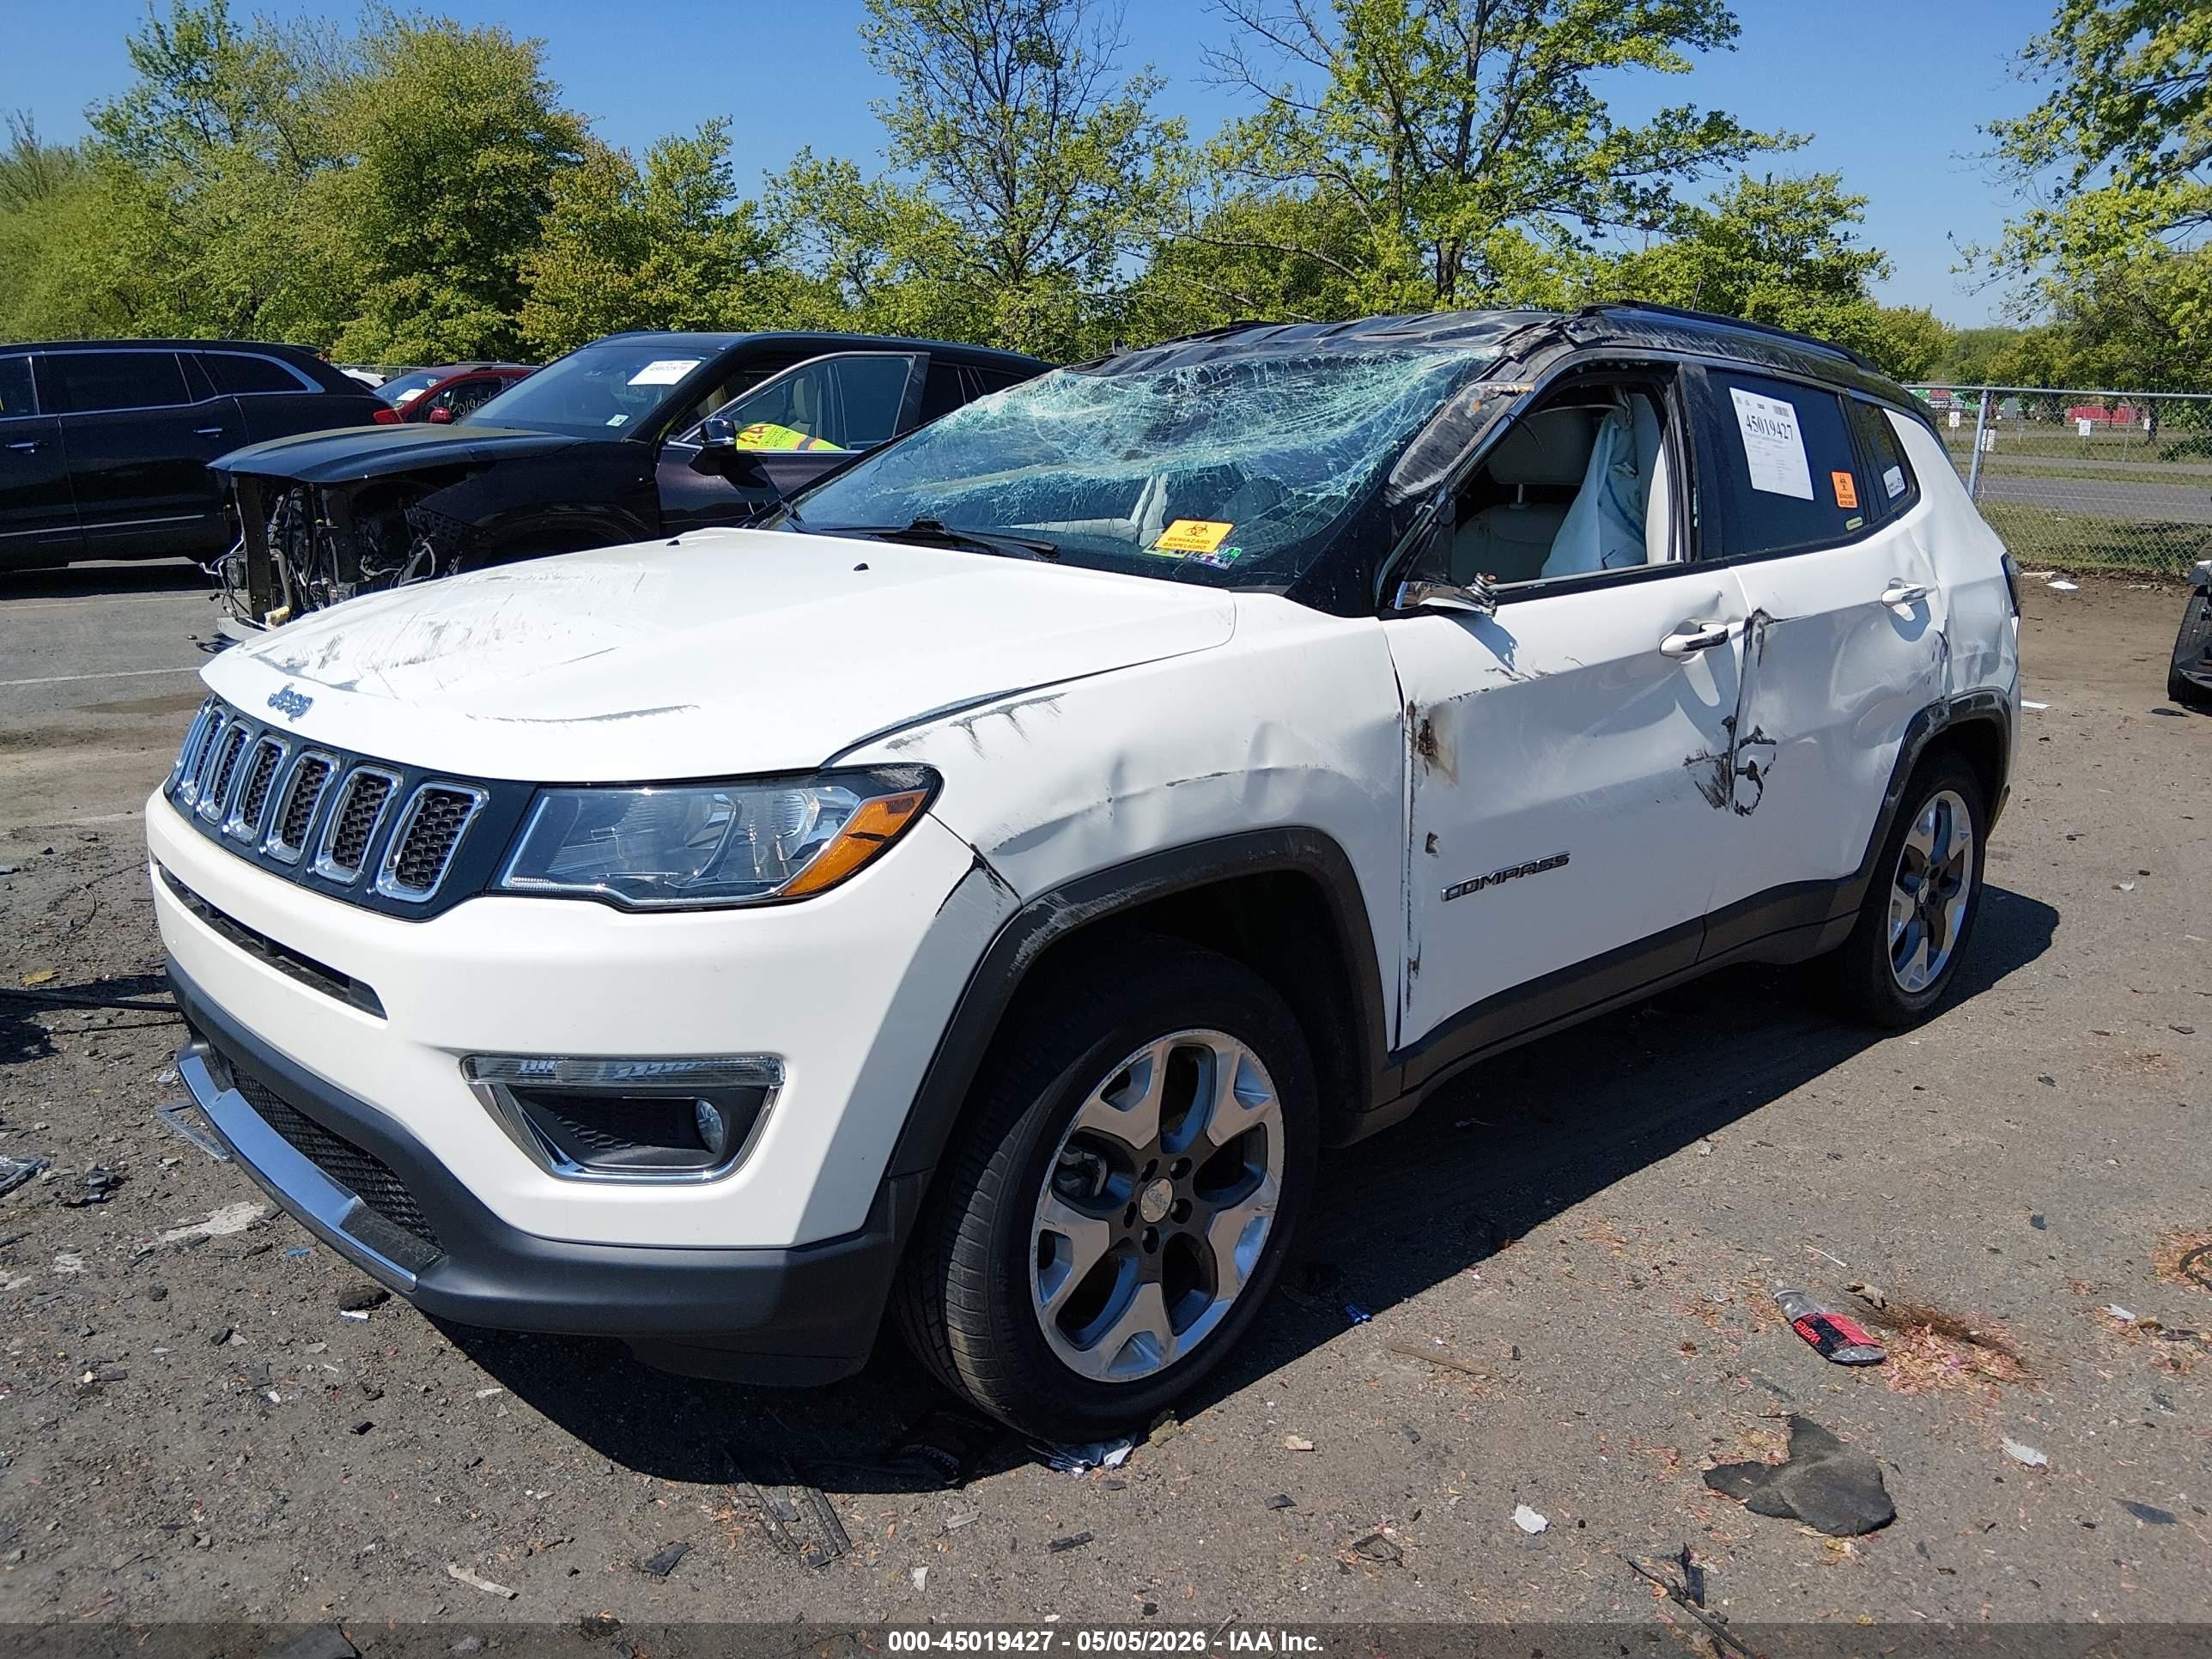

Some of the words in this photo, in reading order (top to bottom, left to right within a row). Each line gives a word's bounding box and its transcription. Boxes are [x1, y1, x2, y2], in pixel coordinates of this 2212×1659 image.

[1746, 414, 1793, 441] 45019427
[267, 683, 313, 722] Jeep
[1441, 851, 1571, 902] COMPASS
[1795, 1319, 1821, 1345] water
